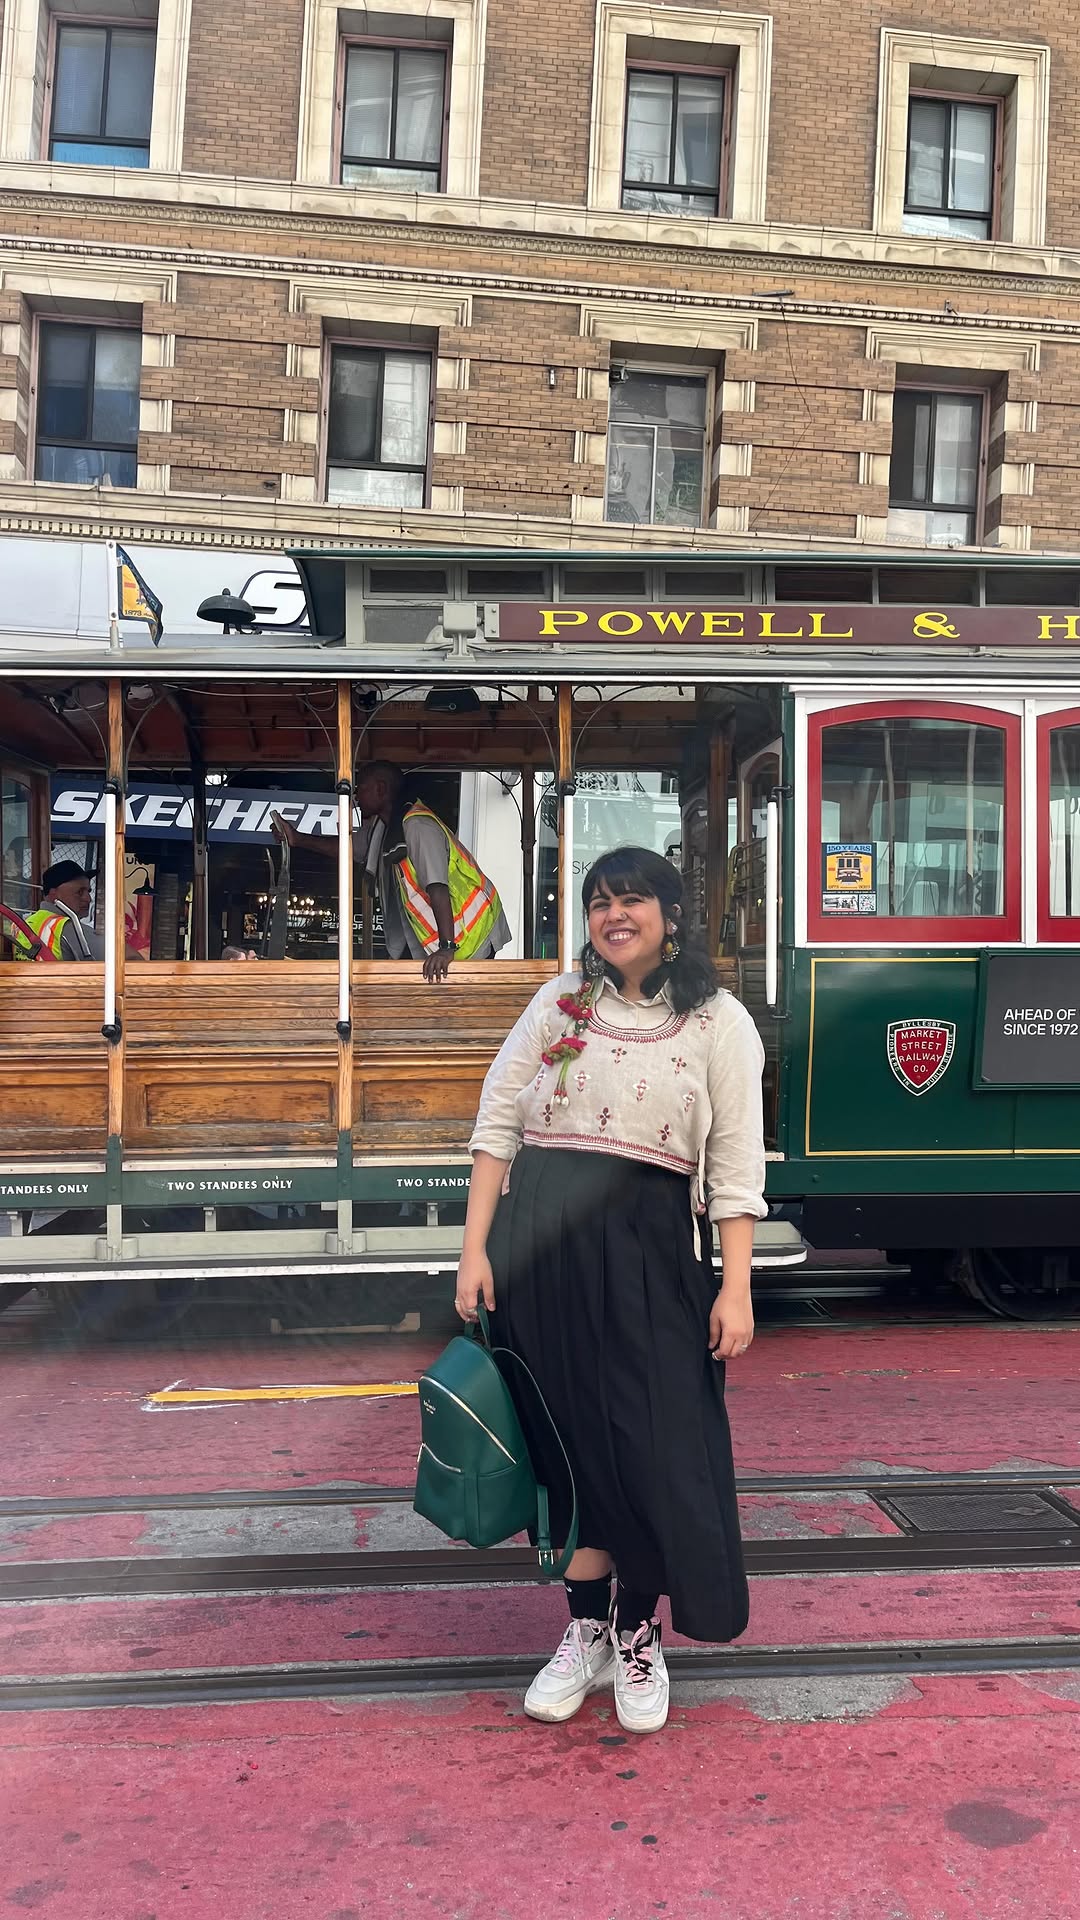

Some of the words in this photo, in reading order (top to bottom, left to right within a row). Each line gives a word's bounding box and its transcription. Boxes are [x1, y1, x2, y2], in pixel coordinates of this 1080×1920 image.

[538, 609, 853, 638] POWELL
[912, 612, 961, 639] &
[1037, 615, 1080, 640] H
[50, 790, 361, 836] SKECHER
[1003, 1008, 1053, 1021] AHEAD
[1056, 1008, 1077, 1021] OF
[901, 1029, 942, 1040] MARKET
[1003, 1023, 1046, 1035] SINCE
[1049, 1023, 1079, 1035] 1972
[901, 1041, 942, 1051] STREET
[899, 1052, 942, 1063] RAILWAY
[913, 1064, 929, 1073] CO.
[167, 1181, 195, 1191] TWO
[199, 1180, 258, 1190] STANDEES
[262, 1180, 293, 1189] ONLY
[395, 1178, 423, 1187] TWO
[57, 1184, 89, 1194] ONLY
